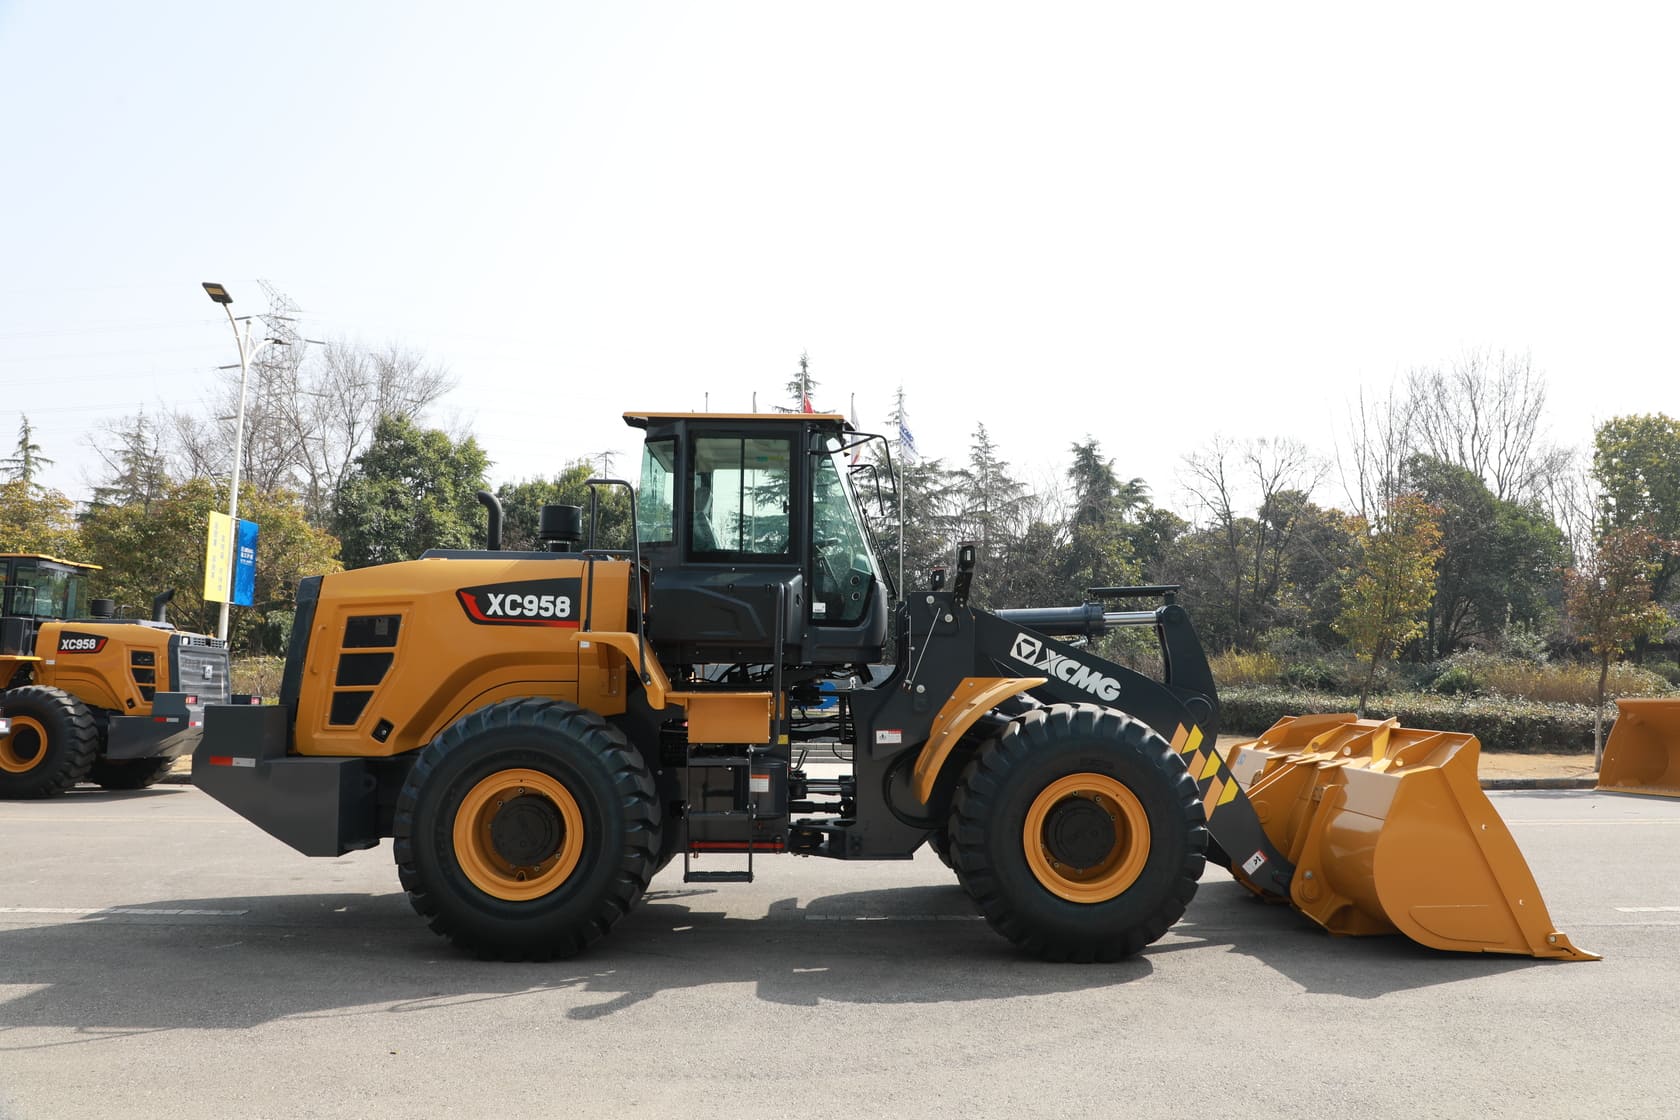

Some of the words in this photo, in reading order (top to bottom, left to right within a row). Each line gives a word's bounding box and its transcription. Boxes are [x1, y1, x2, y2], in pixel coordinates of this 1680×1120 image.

[486, 593, 571, 618] XC958
[60, 638, 96, 650] XC958
[1033, 648, 1121, 701] XCMG
